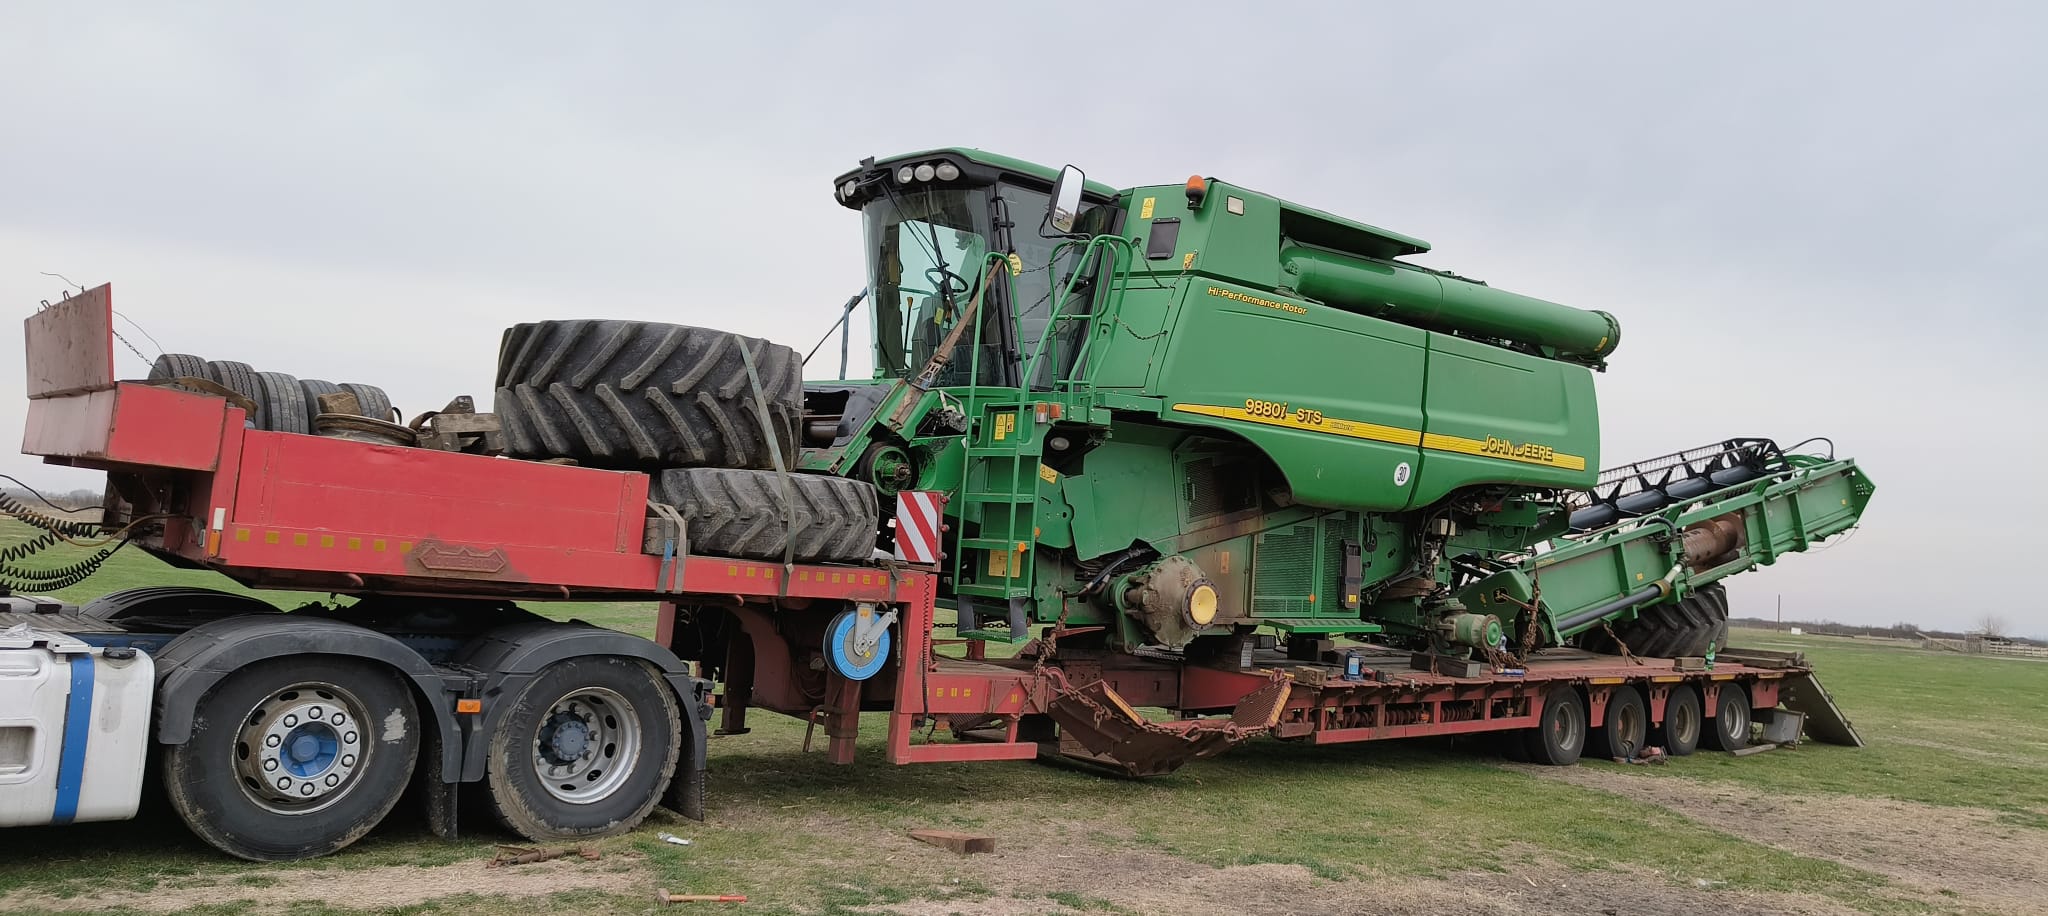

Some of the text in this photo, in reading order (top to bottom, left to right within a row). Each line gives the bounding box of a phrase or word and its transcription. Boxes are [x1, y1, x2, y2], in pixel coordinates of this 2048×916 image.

[1208, 286, 1308, 315] Hi-Performance Rotor
[1245, 398, 1323, 425] 9880i STS
[1481, 433, 1514, 456] JOHN
[1397, 465, 1408, 482] 30
